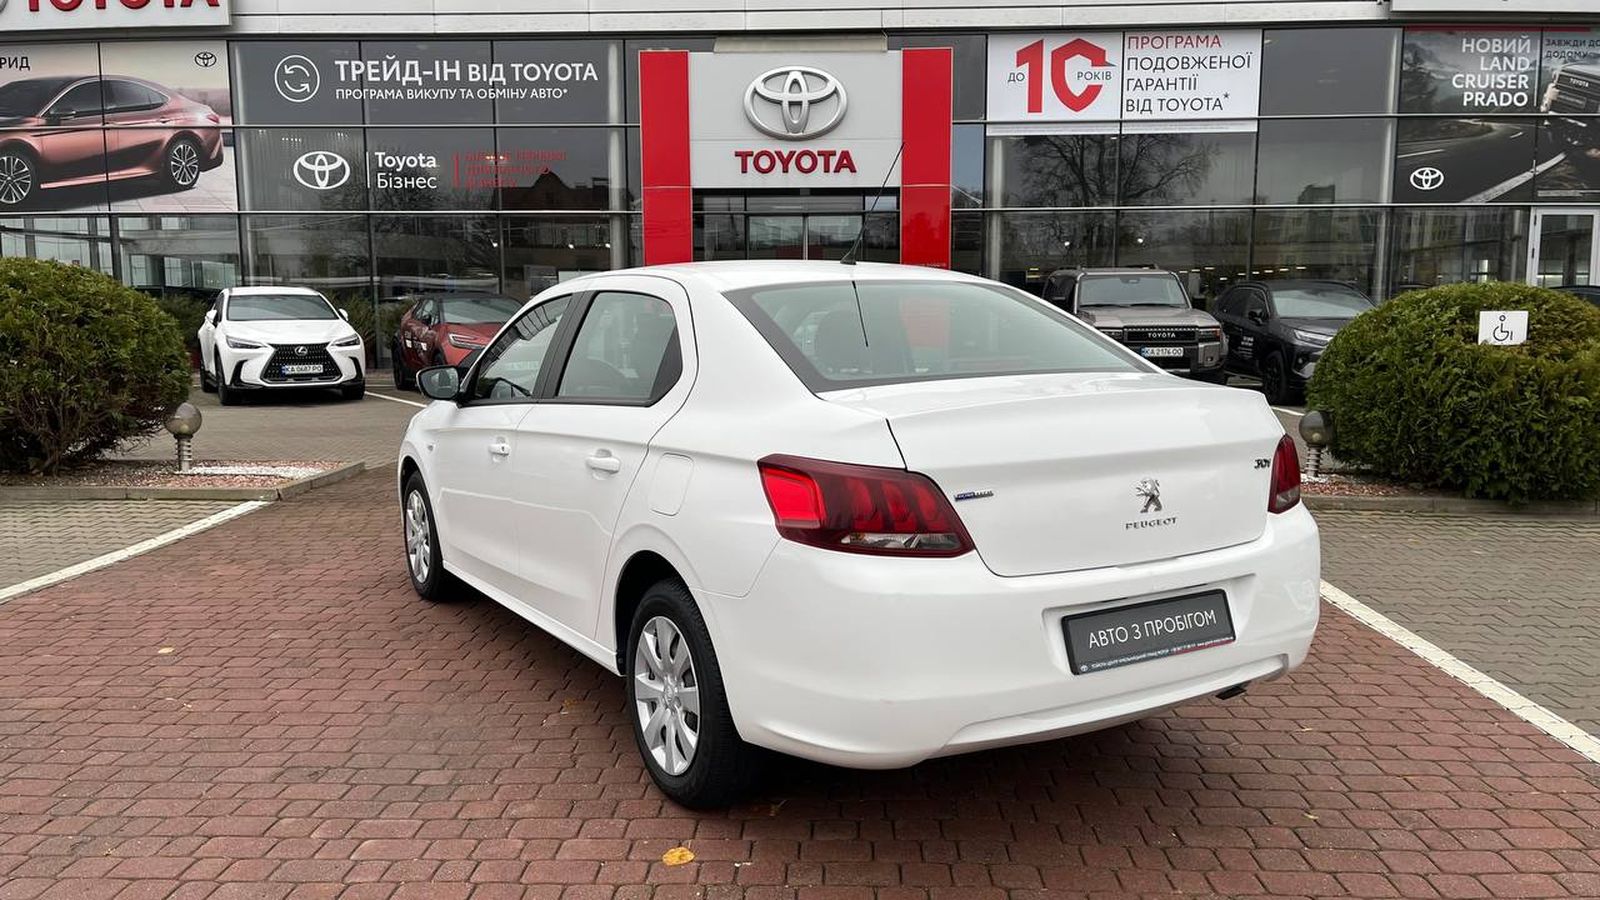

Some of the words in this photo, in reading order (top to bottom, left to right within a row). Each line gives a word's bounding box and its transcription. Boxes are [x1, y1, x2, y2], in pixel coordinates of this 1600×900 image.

[1128, 35, 1221, 49] ПРОГРАМА
[1462, 36, 1531, 53] НОВИЙ
[1127, 52, 1252, 72] ПОДОВЖЕНОЇ
[1480, 57, 1530, 71] LAND
[335, 55, 460, 85] ТРЕЙД-ІН
[469, 64, 506, 85] ВІД
[512, 63, 598, 81] TOYOTA
[1008, 72, 1025, 82] ДО
[1077, 72, 1112, 81] РОКІВ
[1127, 74, 1197, 91] ГАРАНТІЇ
[1453, 74, 1529, 88] CRUISER
[336, 89, 403, 99] ПРОГРАМА
[407, 89, 458, 99] ВИКУПУ
[459, 89, 473, 99] ТА
[477, 89, 526, 99] ОБМІНУ
[1463, 92, 1528, 106] PRADO
[1126, 99, 1152, 113] ВІД
[375, 152, 436, 171] Toyota
[735, 150, 857, 174] TOYOTA
[377, 173, 437, 189] Бізнес
[1126, 516, 1176, 530] PEUGEOT
[1089, 627, 1128, 649] АВТО
[1144, 610, 1216, 637] ПРОБІГОМ
